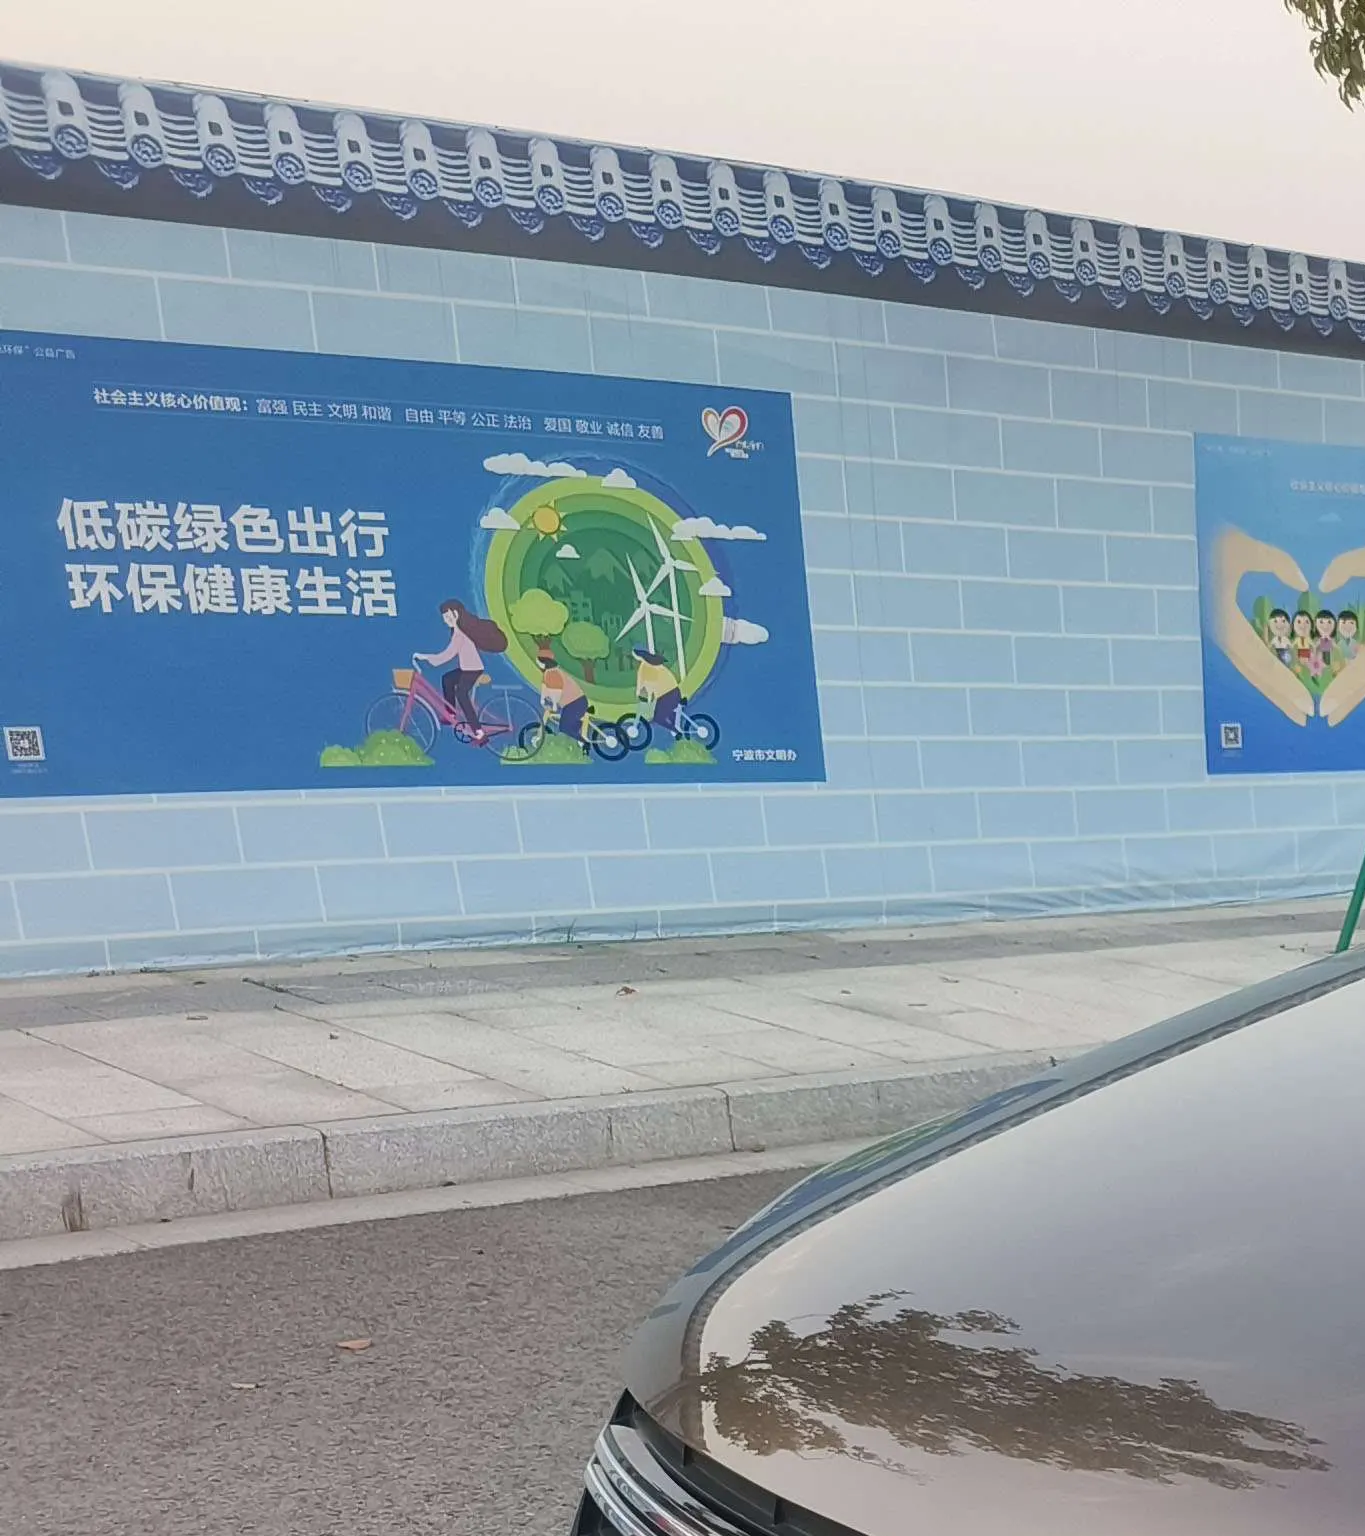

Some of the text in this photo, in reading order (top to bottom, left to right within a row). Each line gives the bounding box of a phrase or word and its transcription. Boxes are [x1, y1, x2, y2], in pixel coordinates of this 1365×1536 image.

[93, 387, 664, 440] 社会主义核心价值观： 富强 民主 文明 和谐 自由 平等 公正 法治 爱国 敬业 诚信 友善
[56, 497, 389, 558] 低碳绿色出行
[64, 562, 398, 617] 环保健康生活
